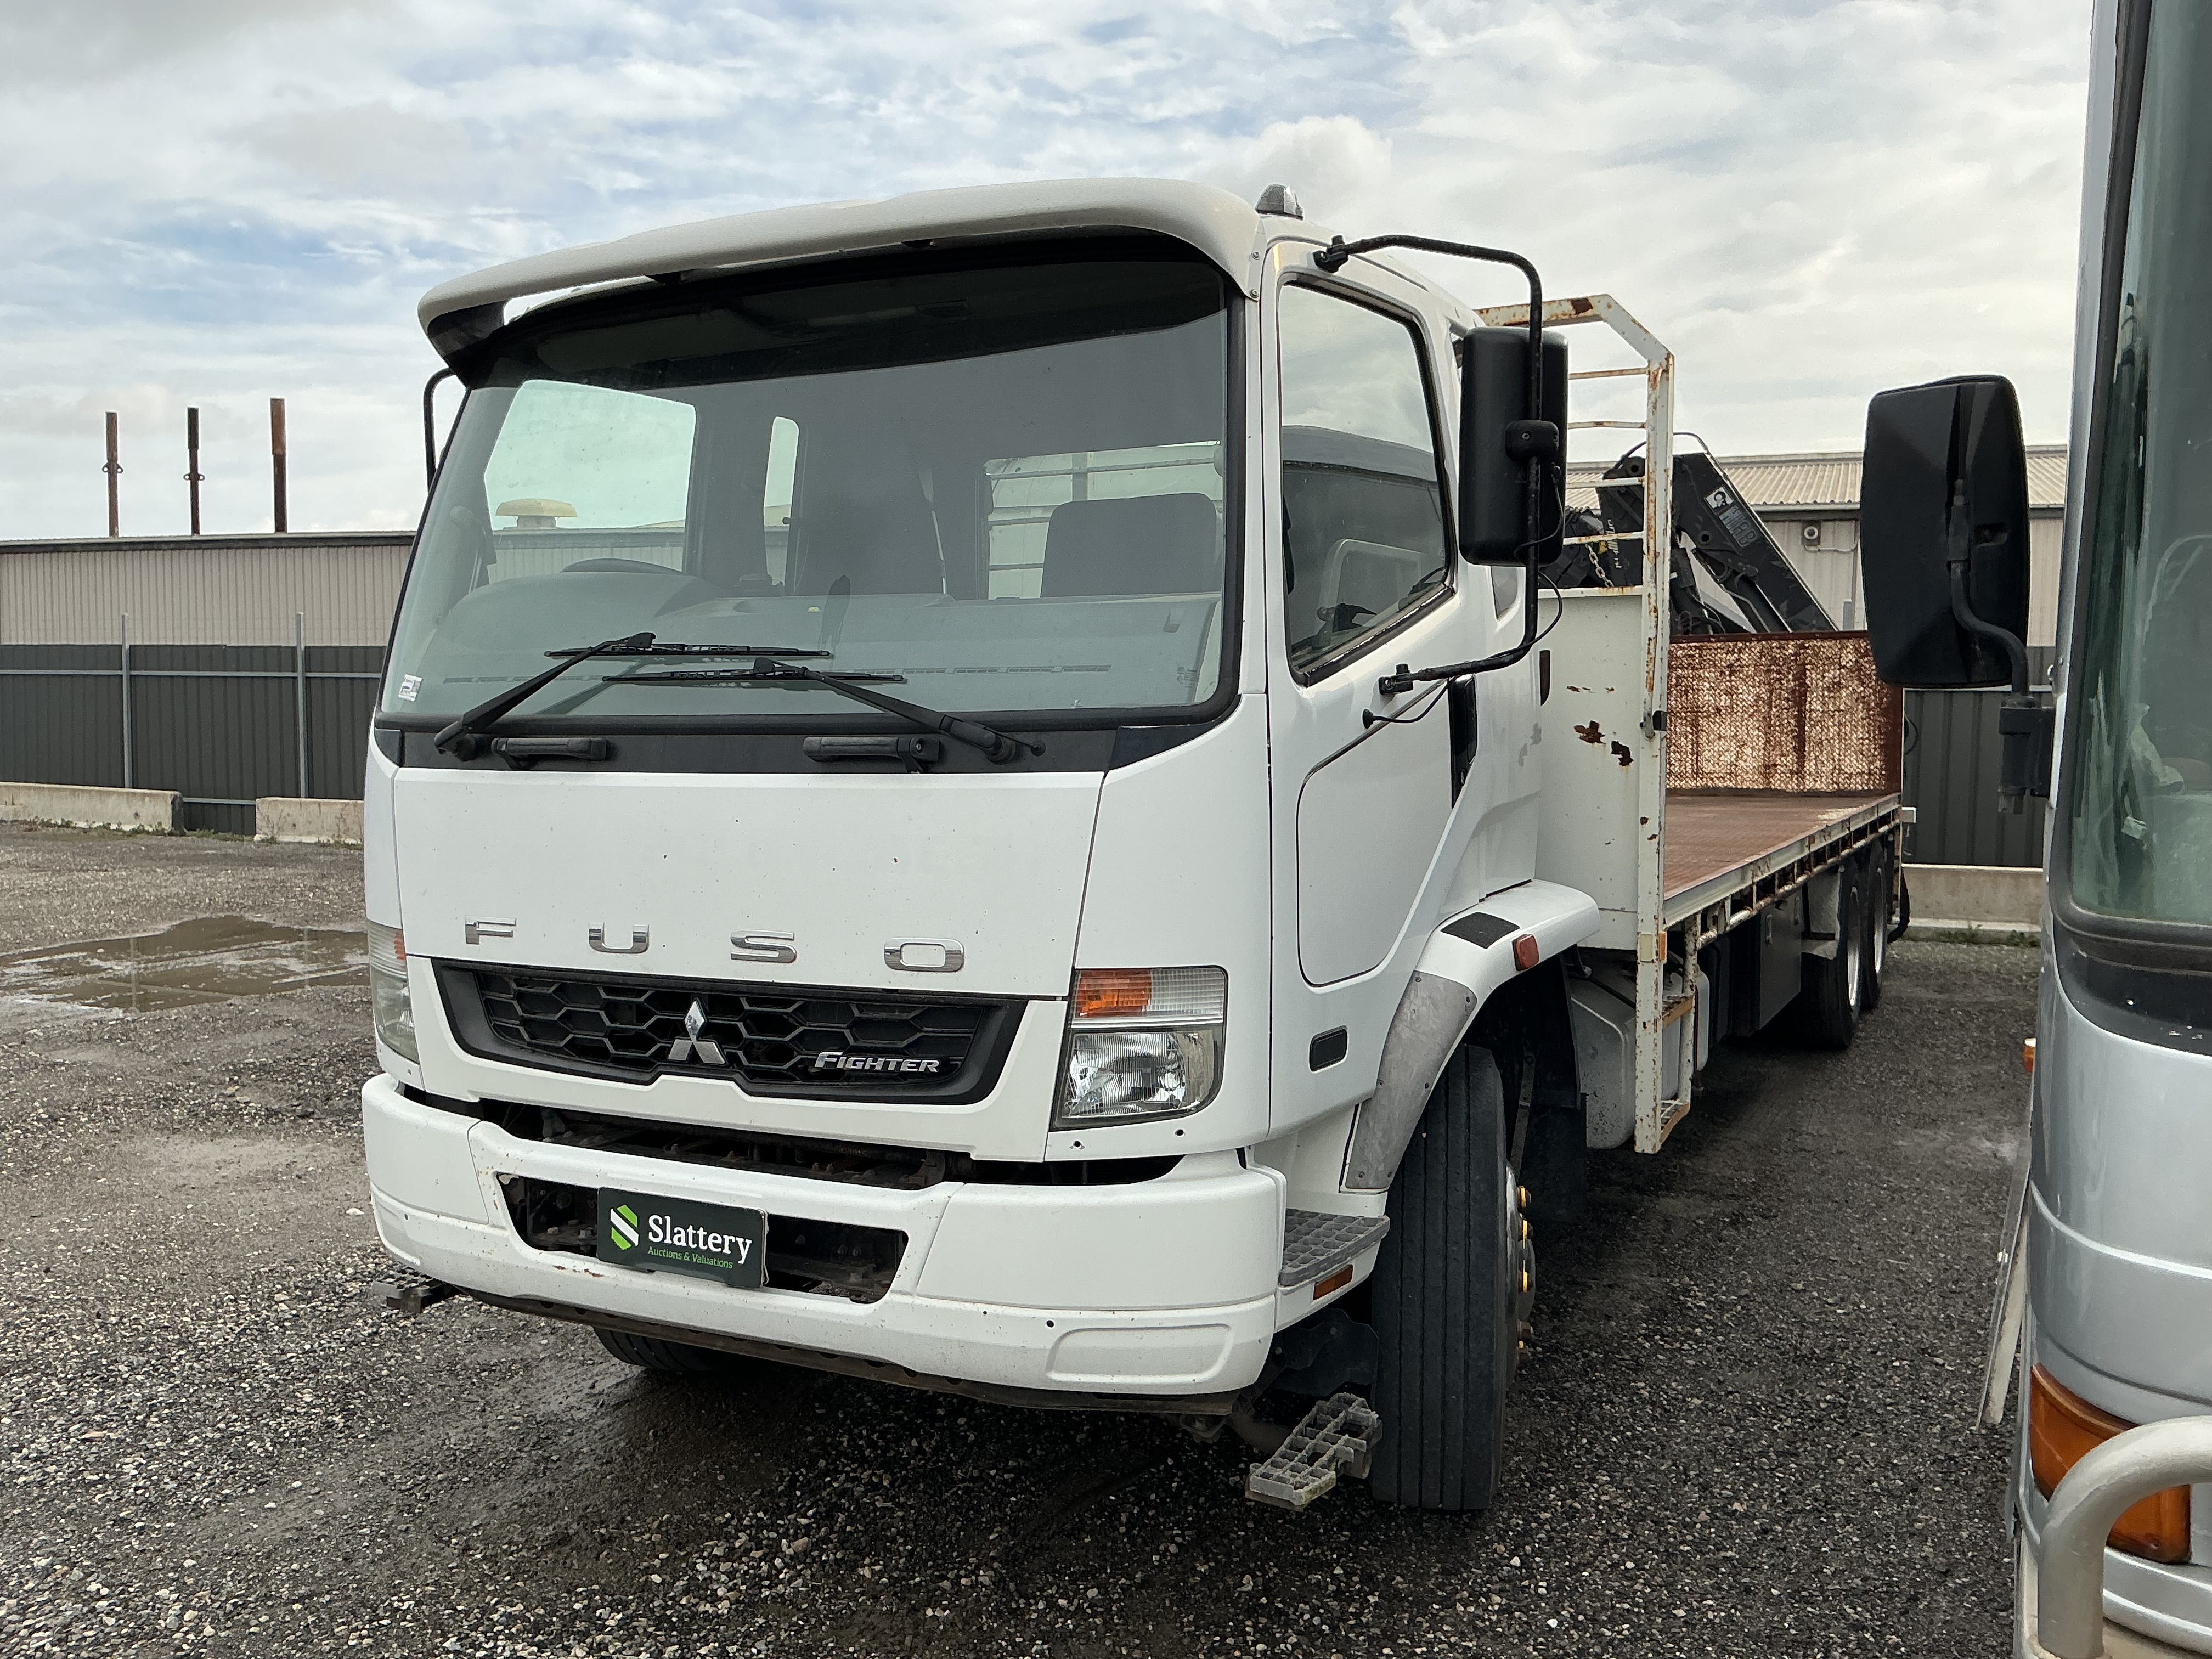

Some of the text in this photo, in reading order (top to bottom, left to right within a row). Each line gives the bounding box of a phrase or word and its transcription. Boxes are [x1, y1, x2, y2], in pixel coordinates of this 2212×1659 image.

[1719, 505, 1757, 548] HIAB
[465, 916, 965, 973] FUSO
[814, 1051, 940, 1073] FIGHTER
[647, 1246, 733, 1269] Auctions & Valuations
[648, 1215, 752, 1265] Slattery
